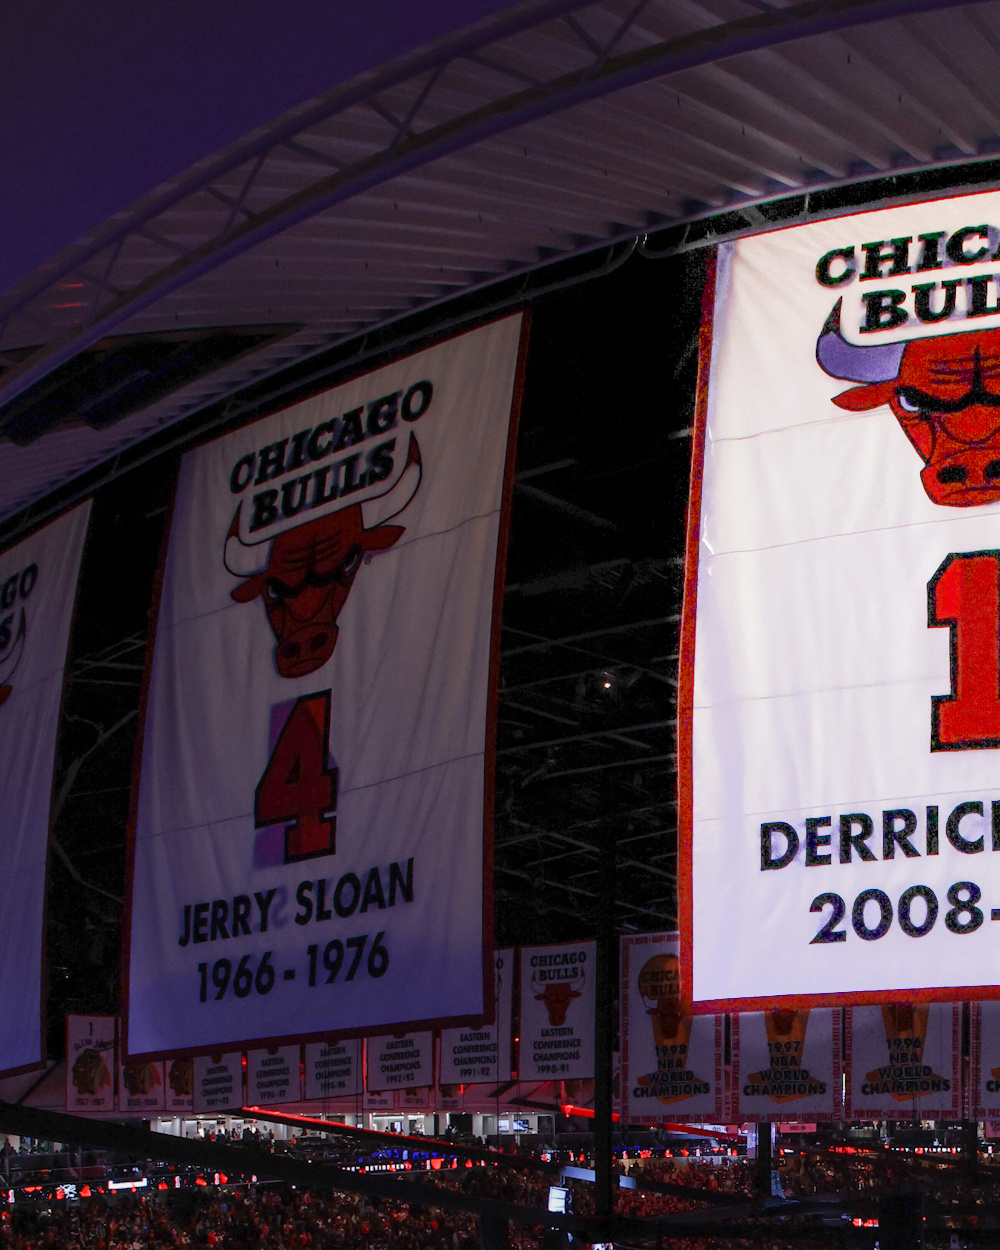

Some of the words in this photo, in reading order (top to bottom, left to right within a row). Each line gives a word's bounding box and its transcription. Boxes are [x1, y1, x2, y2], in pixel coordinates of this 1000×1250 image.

[229, 379, 434, 494] CHICAGO
[249, 437, 398, 534] BULLS
[254, 688, 339, 865] 4
[178, 888, 277, 948] JERRY
[294, 857, 414, 927] SLOAN
[530, 951, 587, 967] CHICAGO
[539, 967, 579, 981] BULLS
[460, 1032, 490, 1042] EASTERN
[541, 1027, 573, 1038] EASTERN
[386, 1039, 414, 1050] EASTERN
[453, 1043, 497, 1055] CONFERENCE
[533, 1039, 581, 1050] CONFERENCE
[767, 1041, 801, 1053] 1997
[886, 1036, 921, 1049] 1996
[380, 1049, 420, 1061] CONFERENCE
[533, 1051, 580, 1062] CHAMPIONS
[655, 1044, 687, 1056] 1998
[453, 1055, 496, 1066] CHAMPIONS
[657, 1057, 684, 1070] NBA
[770, 1054, 798, 1067] NBA
[889, 1051, 920, 1063] NBA
[381, 1061, 421, 1073] CHAMPIONS
[878, 1066, 932, 1079] WORLD
[649, 1070, 694, 1083] WORLD
[760, 1069, 810, 1081] WORLD
[633, 1082, 710, 1098] CHAMPIONS
[743, 1082, 826, 1096] CHAMPIONS
[861, 1078, 950, 1095] CHAMPIONS
